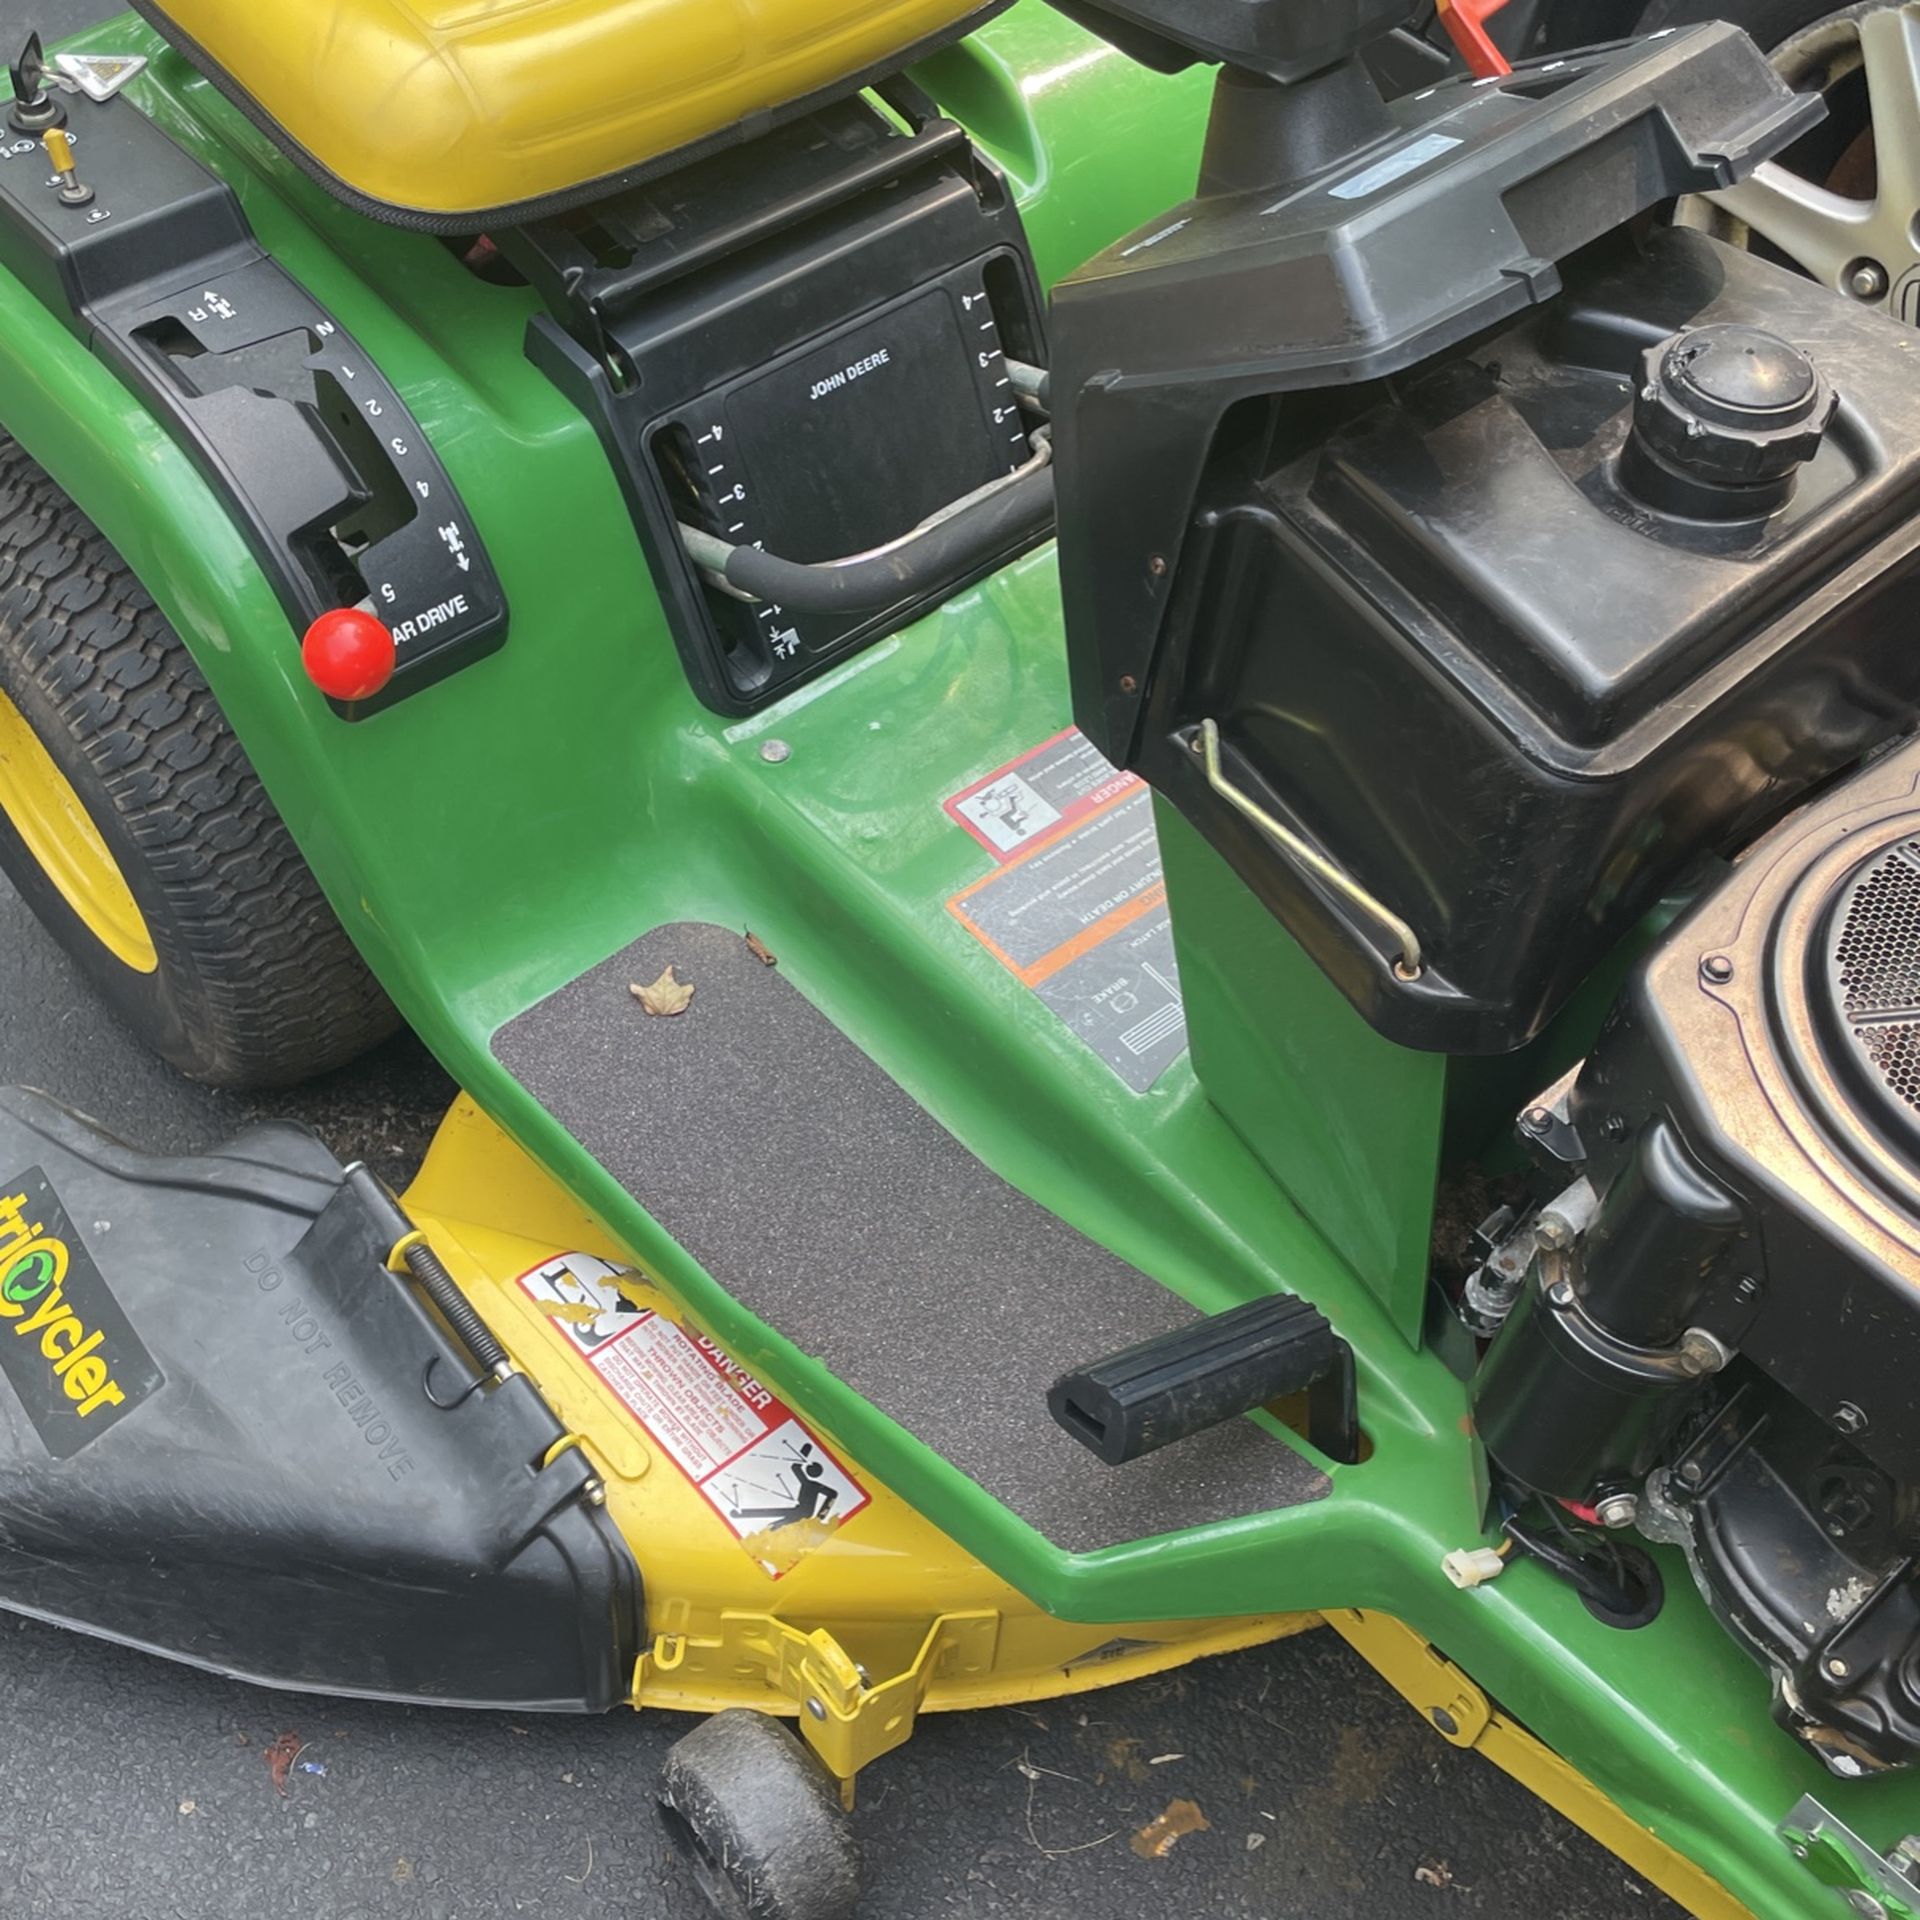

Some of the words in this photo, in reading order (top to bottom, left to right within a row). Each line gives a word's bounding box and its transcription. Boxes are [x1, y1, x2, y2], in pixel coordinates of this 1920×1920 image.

[962, 295, 973, 311] 4
[187, 307, 209, 322] R
[978, 352, 989, 368] 3
[341, 365, 356, 380] 1
[810, 370, 847, 400] JOHN
[845, 348, 890, 381] DEERE
[365, 398, 383, 416] 2
[992, 407, 1004, 424] 2
[711, 424, 723, 441] 4
[391, 436, 408, 456] 3
[415, 480, 430, 499] 4
[733, 483, 746, 501] 3
[381, 582, 396, 603] 5
[415, 593, 470, 634] DRIVE
[1089, 771, 1141, 806] ANGER
[1080, 898, 1115, 924] DEATH
[1091, 977, 1129, 1005] BRAKE
[243, 1249, 284, 1292] DO
[278, 1297, 332, 1354] NOT
[322, 1360, 415, 1482] REMOVE
[672, 1332, 716, 1381] ROTATING
[714, 1380, 745, 1413] BLADE
[697, 1335, 772, 1411] DANGER
[646, 1346, 685, 1389] THROWN
[683, 1388, 724, 1434] OBJECTS
